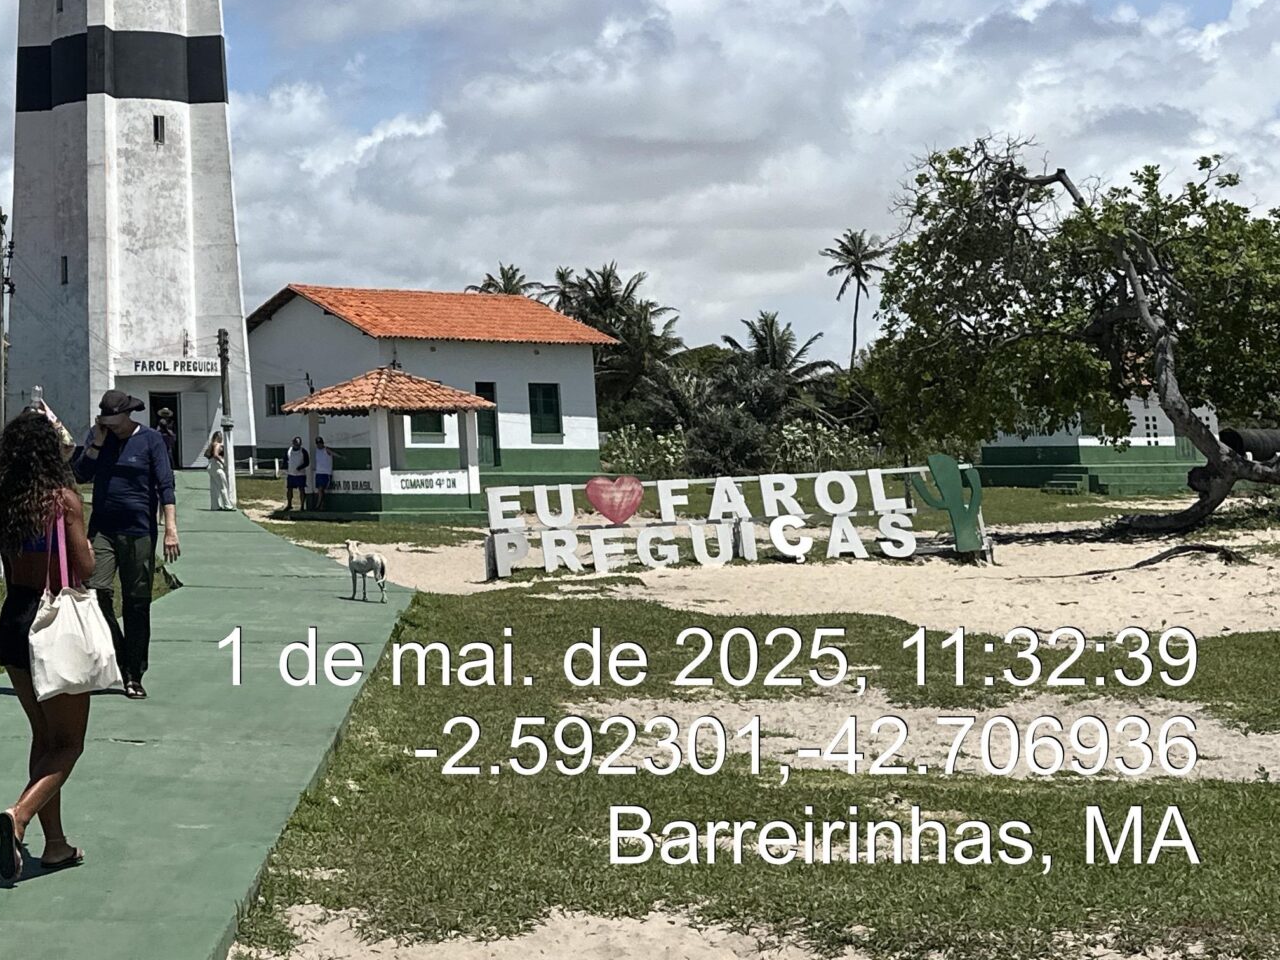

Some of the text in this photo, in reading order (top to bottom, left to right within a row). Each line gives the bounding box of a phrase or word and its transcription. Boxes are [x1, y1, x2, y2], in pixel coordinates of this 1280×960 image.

[134, 360, 169, 372] FAROL
[400, 478, 434, 490] COMANDO
[487, 469, 907, 529] EU FAROL
[493, 514, 917, 578] PREGUIÇAS
